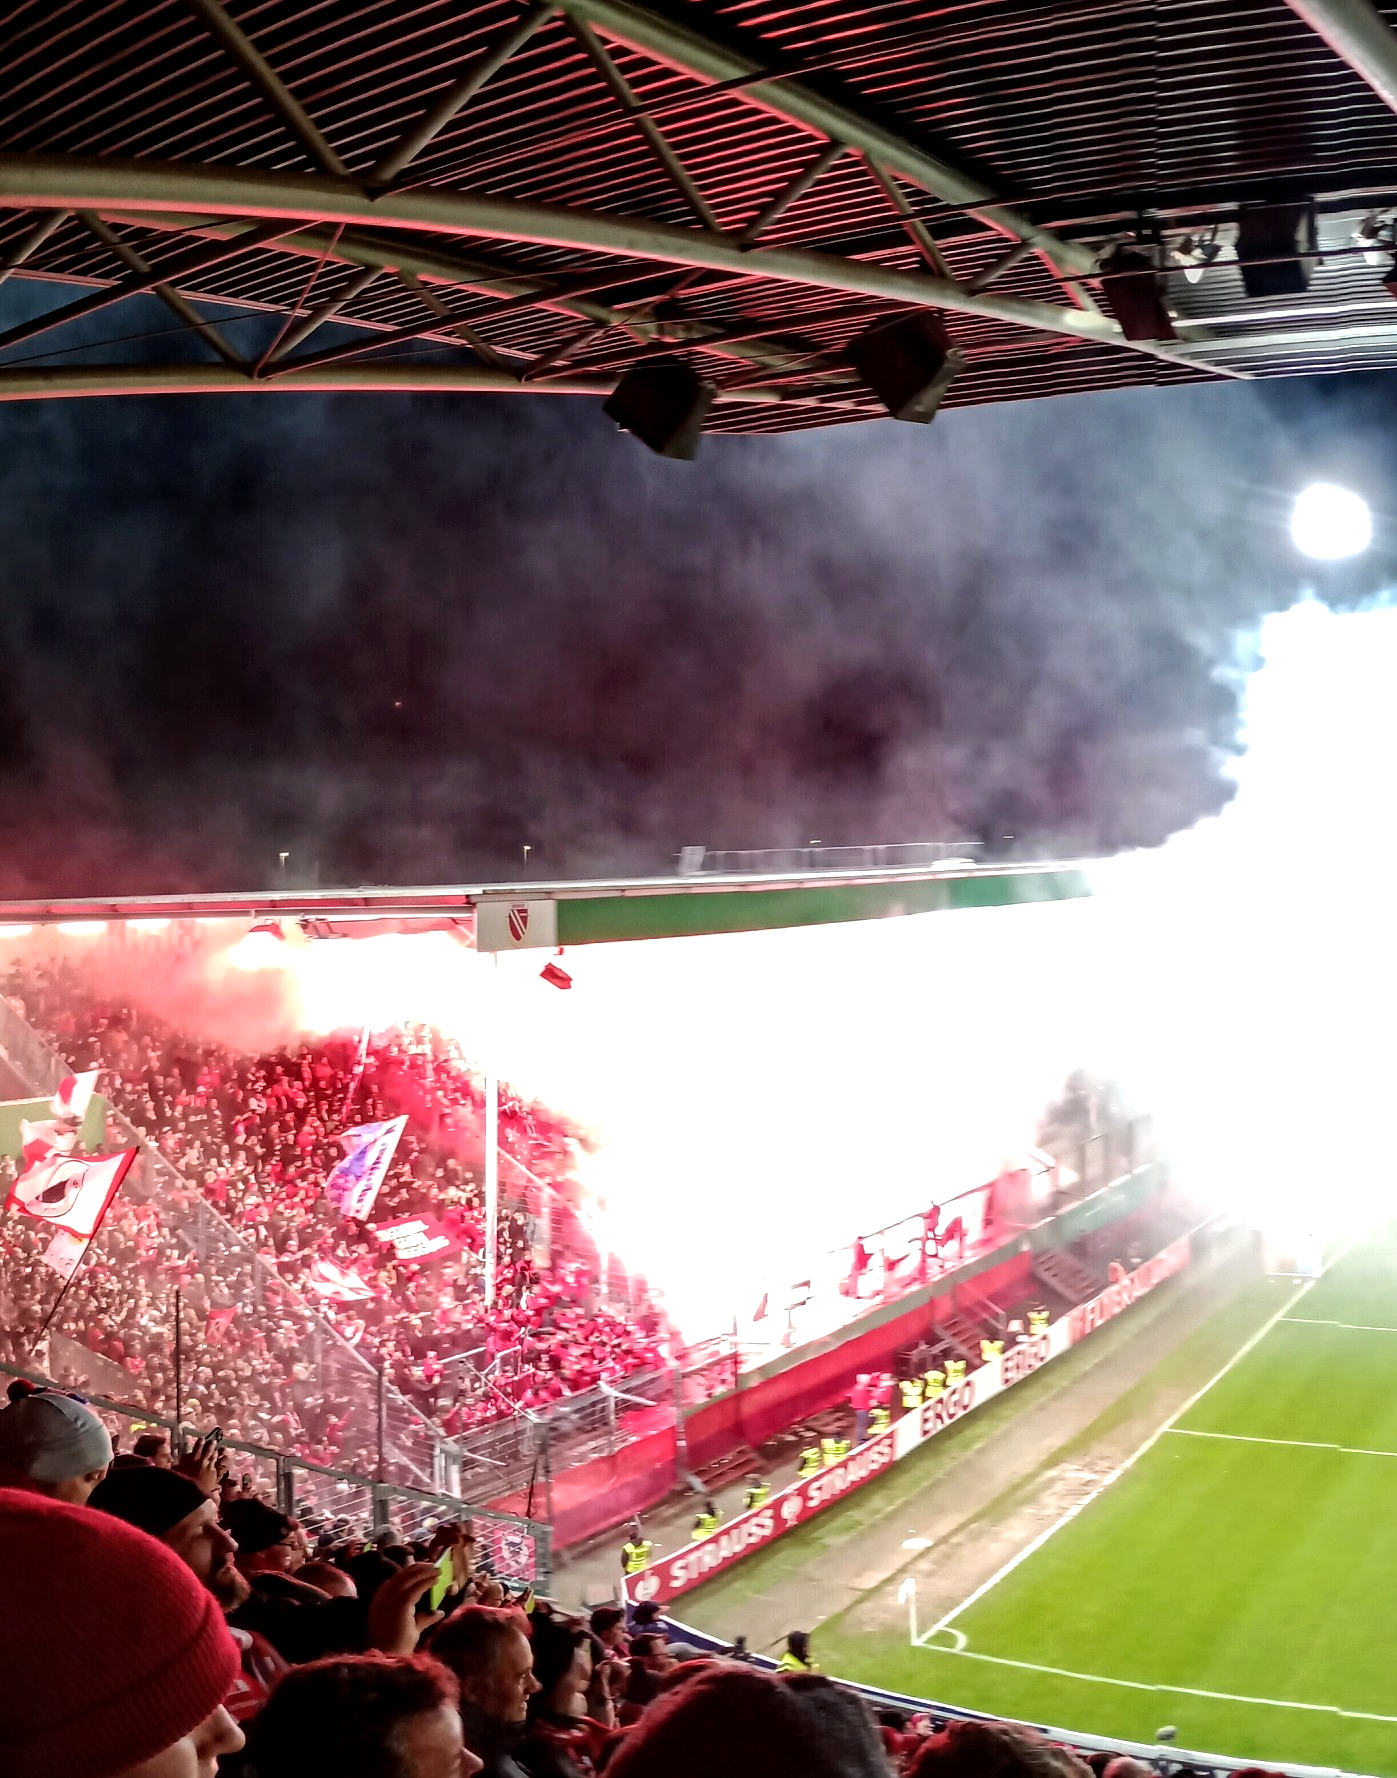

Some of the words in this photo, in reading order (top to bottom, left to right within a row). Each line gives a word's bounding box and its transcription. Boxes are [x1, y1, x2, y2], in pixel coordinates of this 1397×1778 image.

[921, 1380, 976, 1437] ERGO
[669, 1509, 774, 1588] STRAUSS
[805, 1438, 893, 1508] STRAUSS
